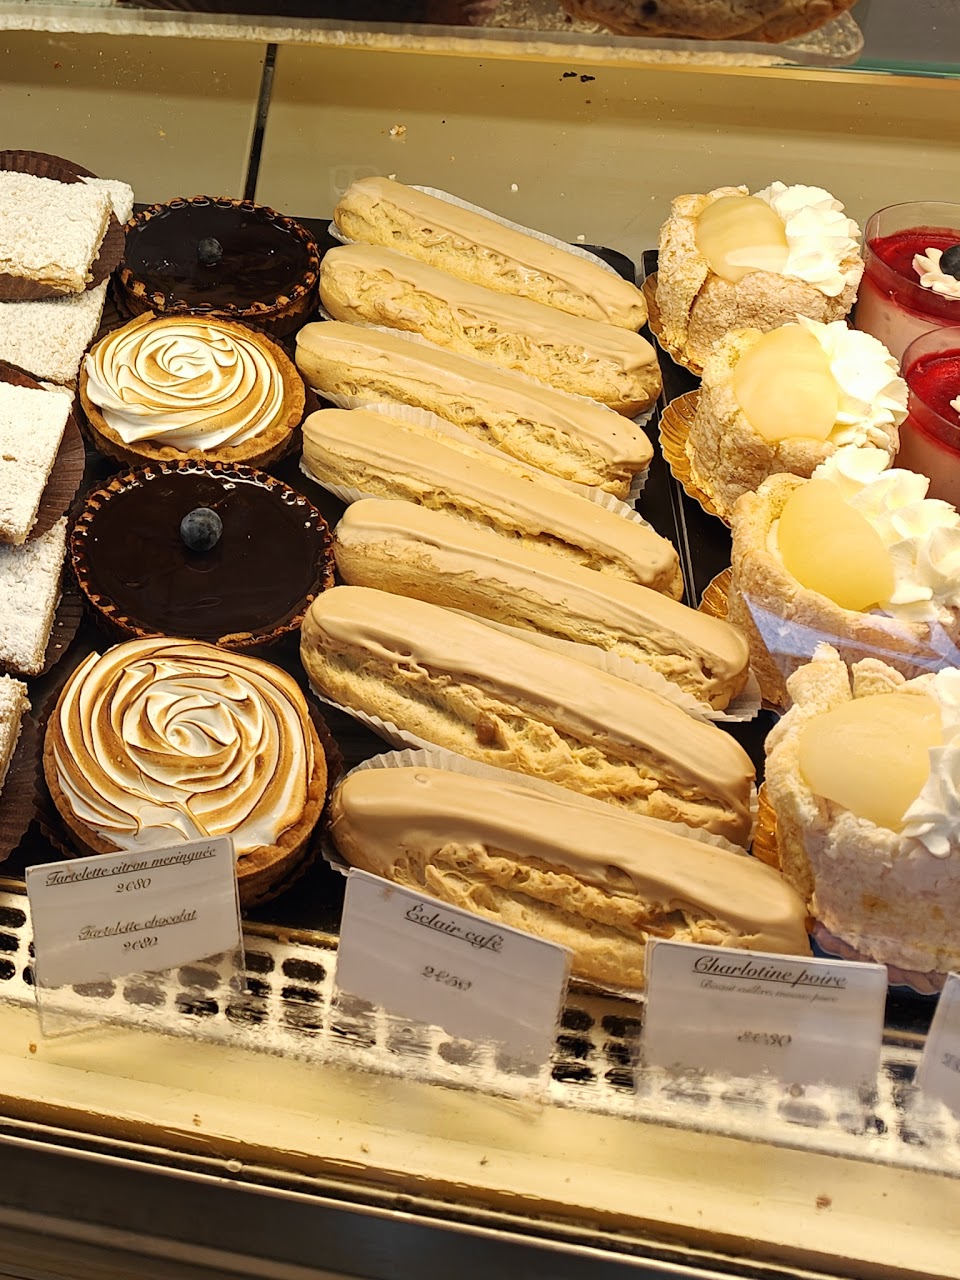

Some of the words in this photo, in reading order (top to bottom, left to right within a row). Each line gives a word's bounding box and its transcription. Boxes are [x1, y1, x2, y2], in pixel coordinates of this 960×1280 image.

[45, 866, 111, 887] Tartelette
[112, 861, 148, 876] citron
[151, 846, 217, 868] meringuée
[115, 878, 152, 893] 2€80
[78, 923, 141, 941] Tartelette
[144, 908, 198, 928] chocolat
[404, 903, 461, 935] Éclair
[464, 932, 504, 954] café
[692, 955, 793, 982] Charlotine
[792, 968, 848, 990] poire
